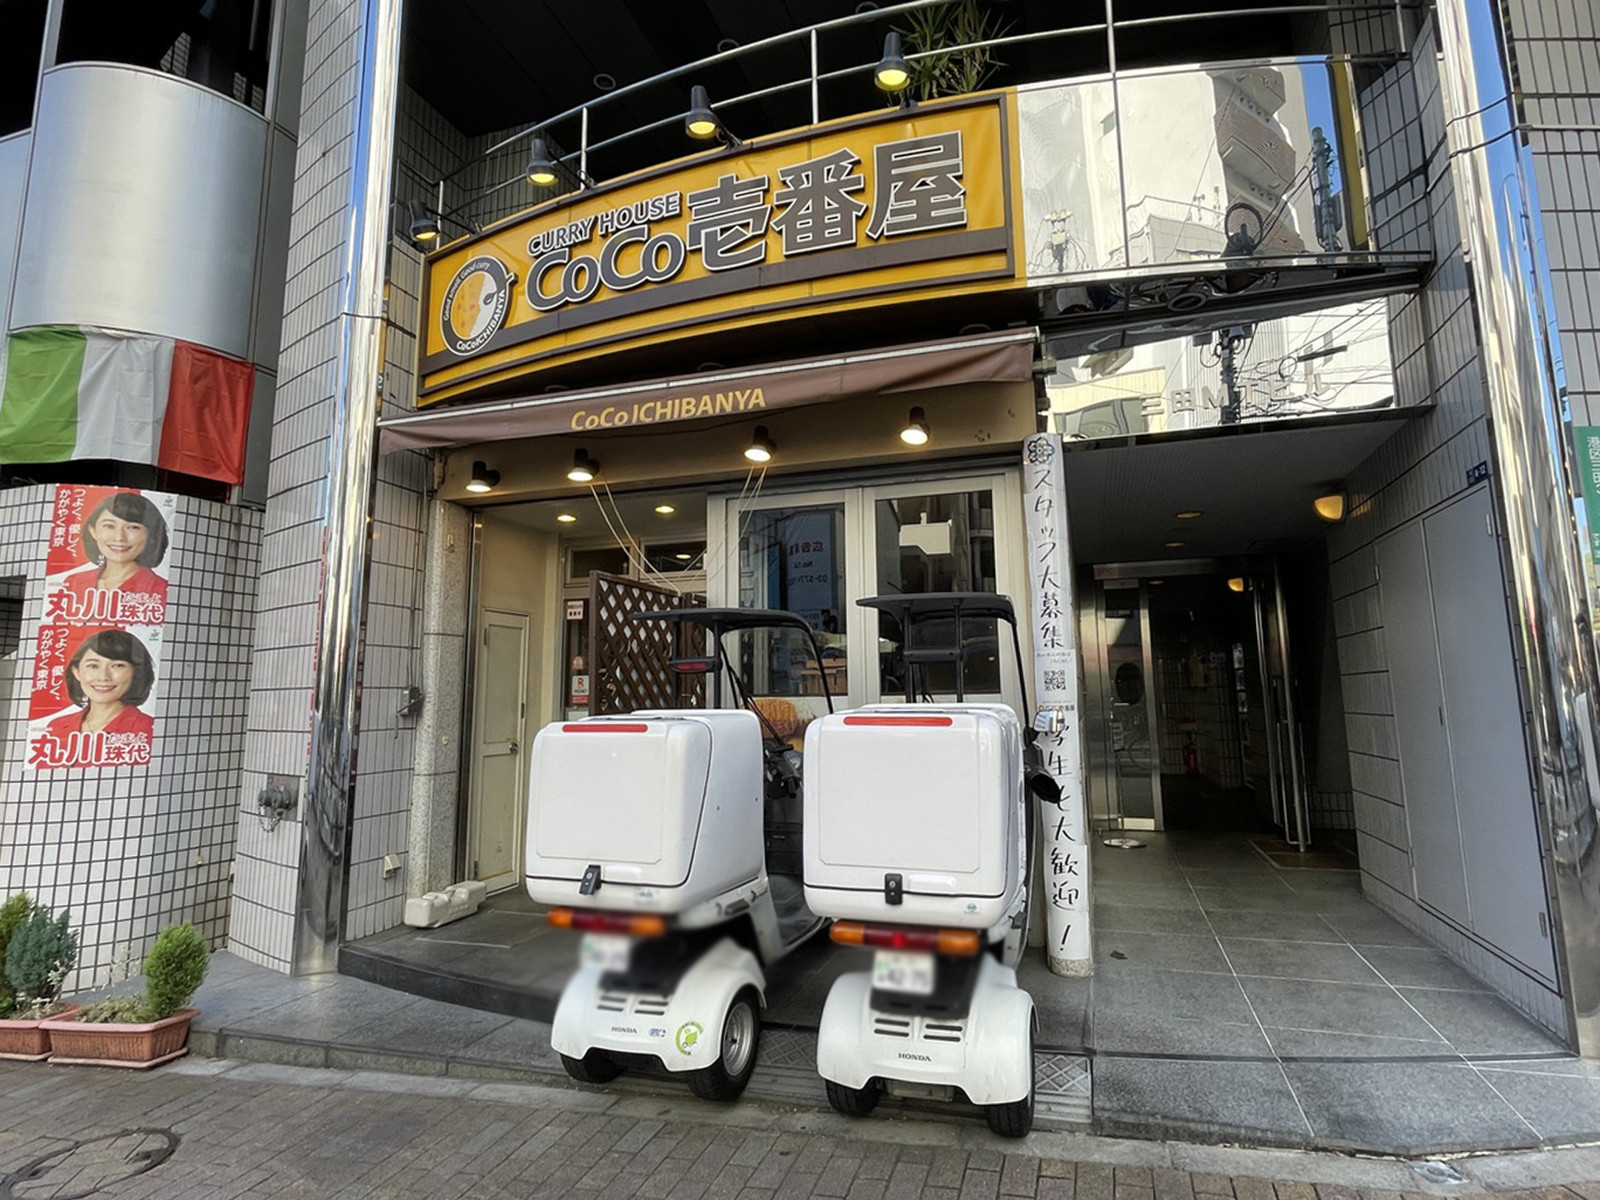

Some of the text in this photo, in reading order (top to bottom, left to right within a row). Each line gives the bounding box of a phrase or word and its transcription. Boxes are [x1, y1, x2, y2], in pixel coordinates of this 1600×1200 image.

[527, 190, 681, 256] CURRY HOUSE
[53, 489, 72, 548] かがやく東京
[1033, 469, 1065, 649] スタッフ大募集
[35, 629, 54, 691] かがやく東京
[611, 1026, 638, 1034] HONDA
[898, 1053, 931, 1062] HONDA
